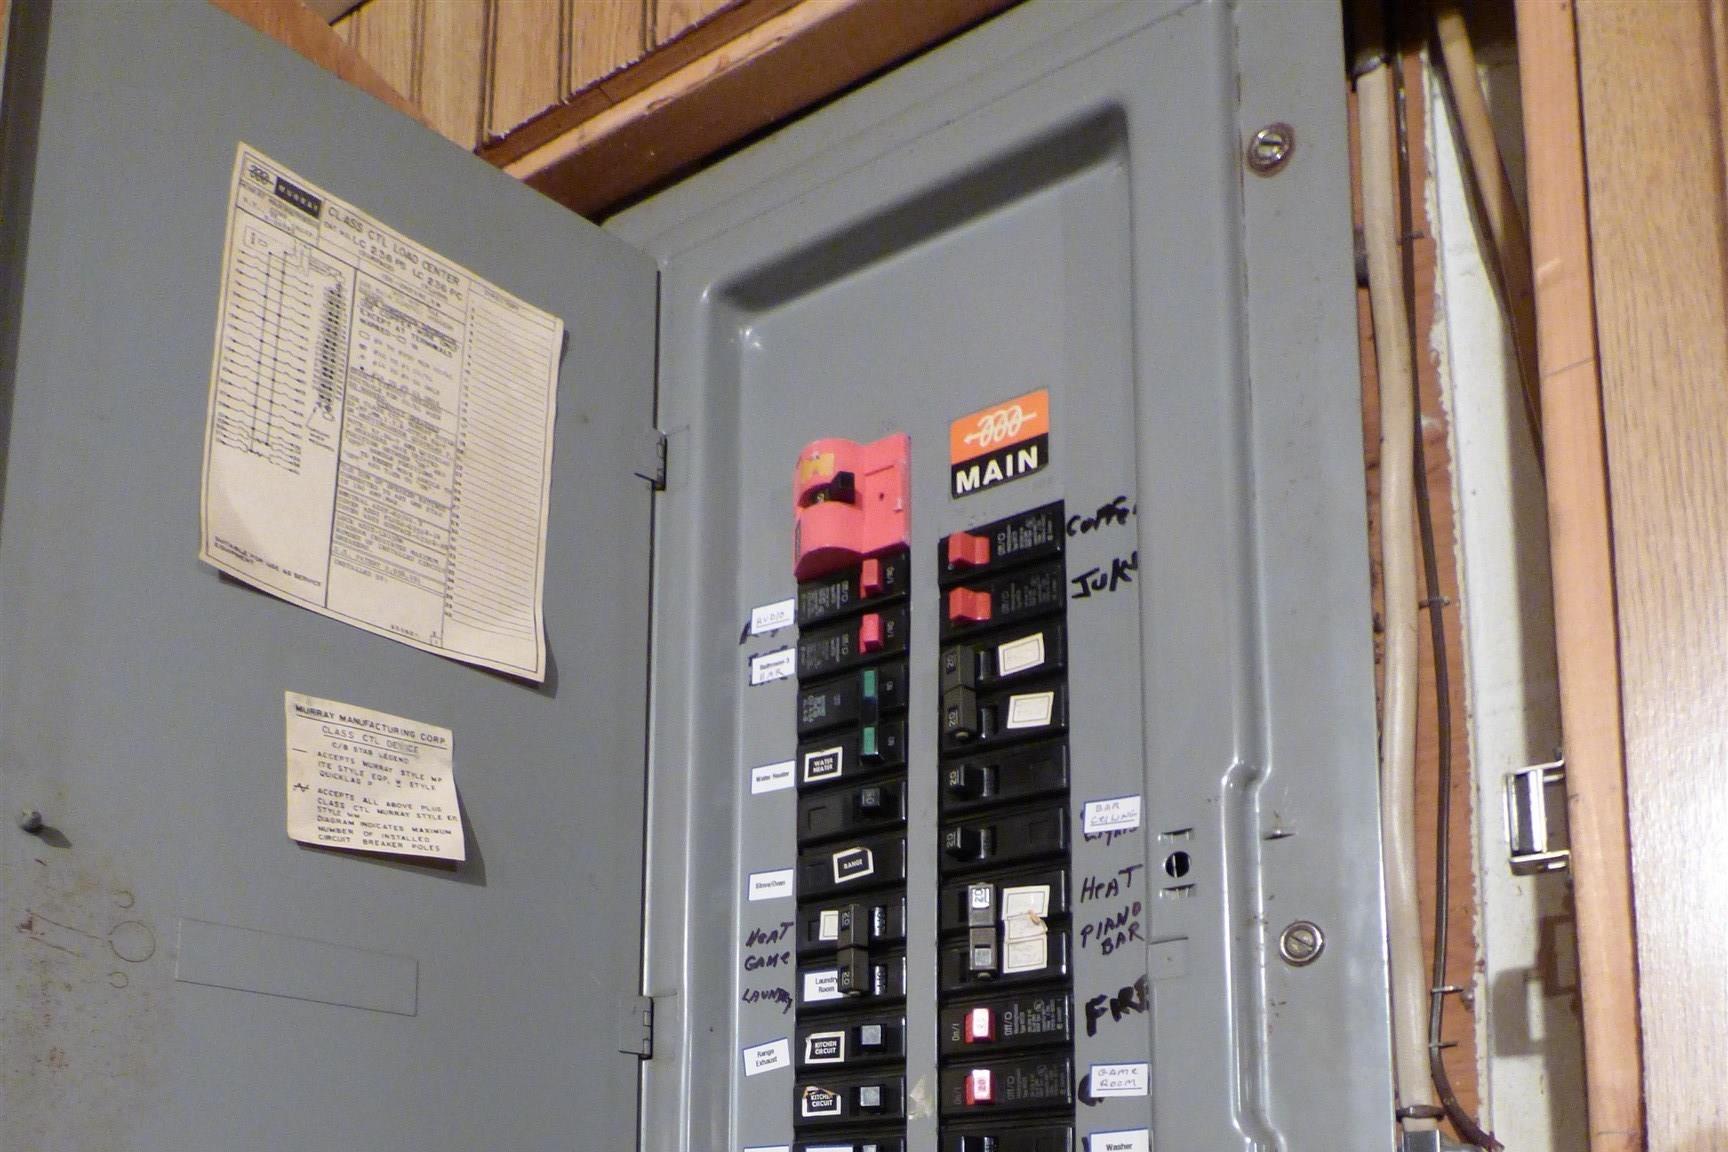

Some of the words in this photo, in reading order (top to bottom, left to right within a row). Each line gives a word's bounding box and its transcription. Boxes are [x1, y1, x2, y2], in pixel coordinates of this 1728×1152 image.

[955, 445, 1039, 496] MAIN
[295, 704, 336, 720] MURRAY
[339, 713, 416, 739] MANUFACTURING
[420, 733, 446, 745] CORP
[321, 725, 354, 740] CLASS
[362, 734, 380, 746] CTL
[317, 751, 356, 765] ACCEPTS
[399, 768, 425, 781] STYLE
[338, 765, 365, 778] STYLE
[317, 788, 355, 801] ACCEPTS
[362, 797, 379, 807] ALL
[386, 800, 413, 811] ABOVE
[317, 797, 345, 809] CLASS
[353, 804, 370, 813] CTL
[416, 812, 443, 821] STYLE
[317, 816, 355, 826] DIAGRAM
[360, 821, 405, 832] INDICATES
[317, 826, 354, 835] NUMBER
[381, 834, 431, 843] INSTALLED
[318, 834, 351, 843] CIRCUIT
[362, 839, 403, 849] BREAKER
[411, 843, 440, 852] POLES
[1080, 901, 1142, 948] PIANO
[1101, 920, 1145, 956] BAR
[1105, 1142, 1134, 1152] Washer
